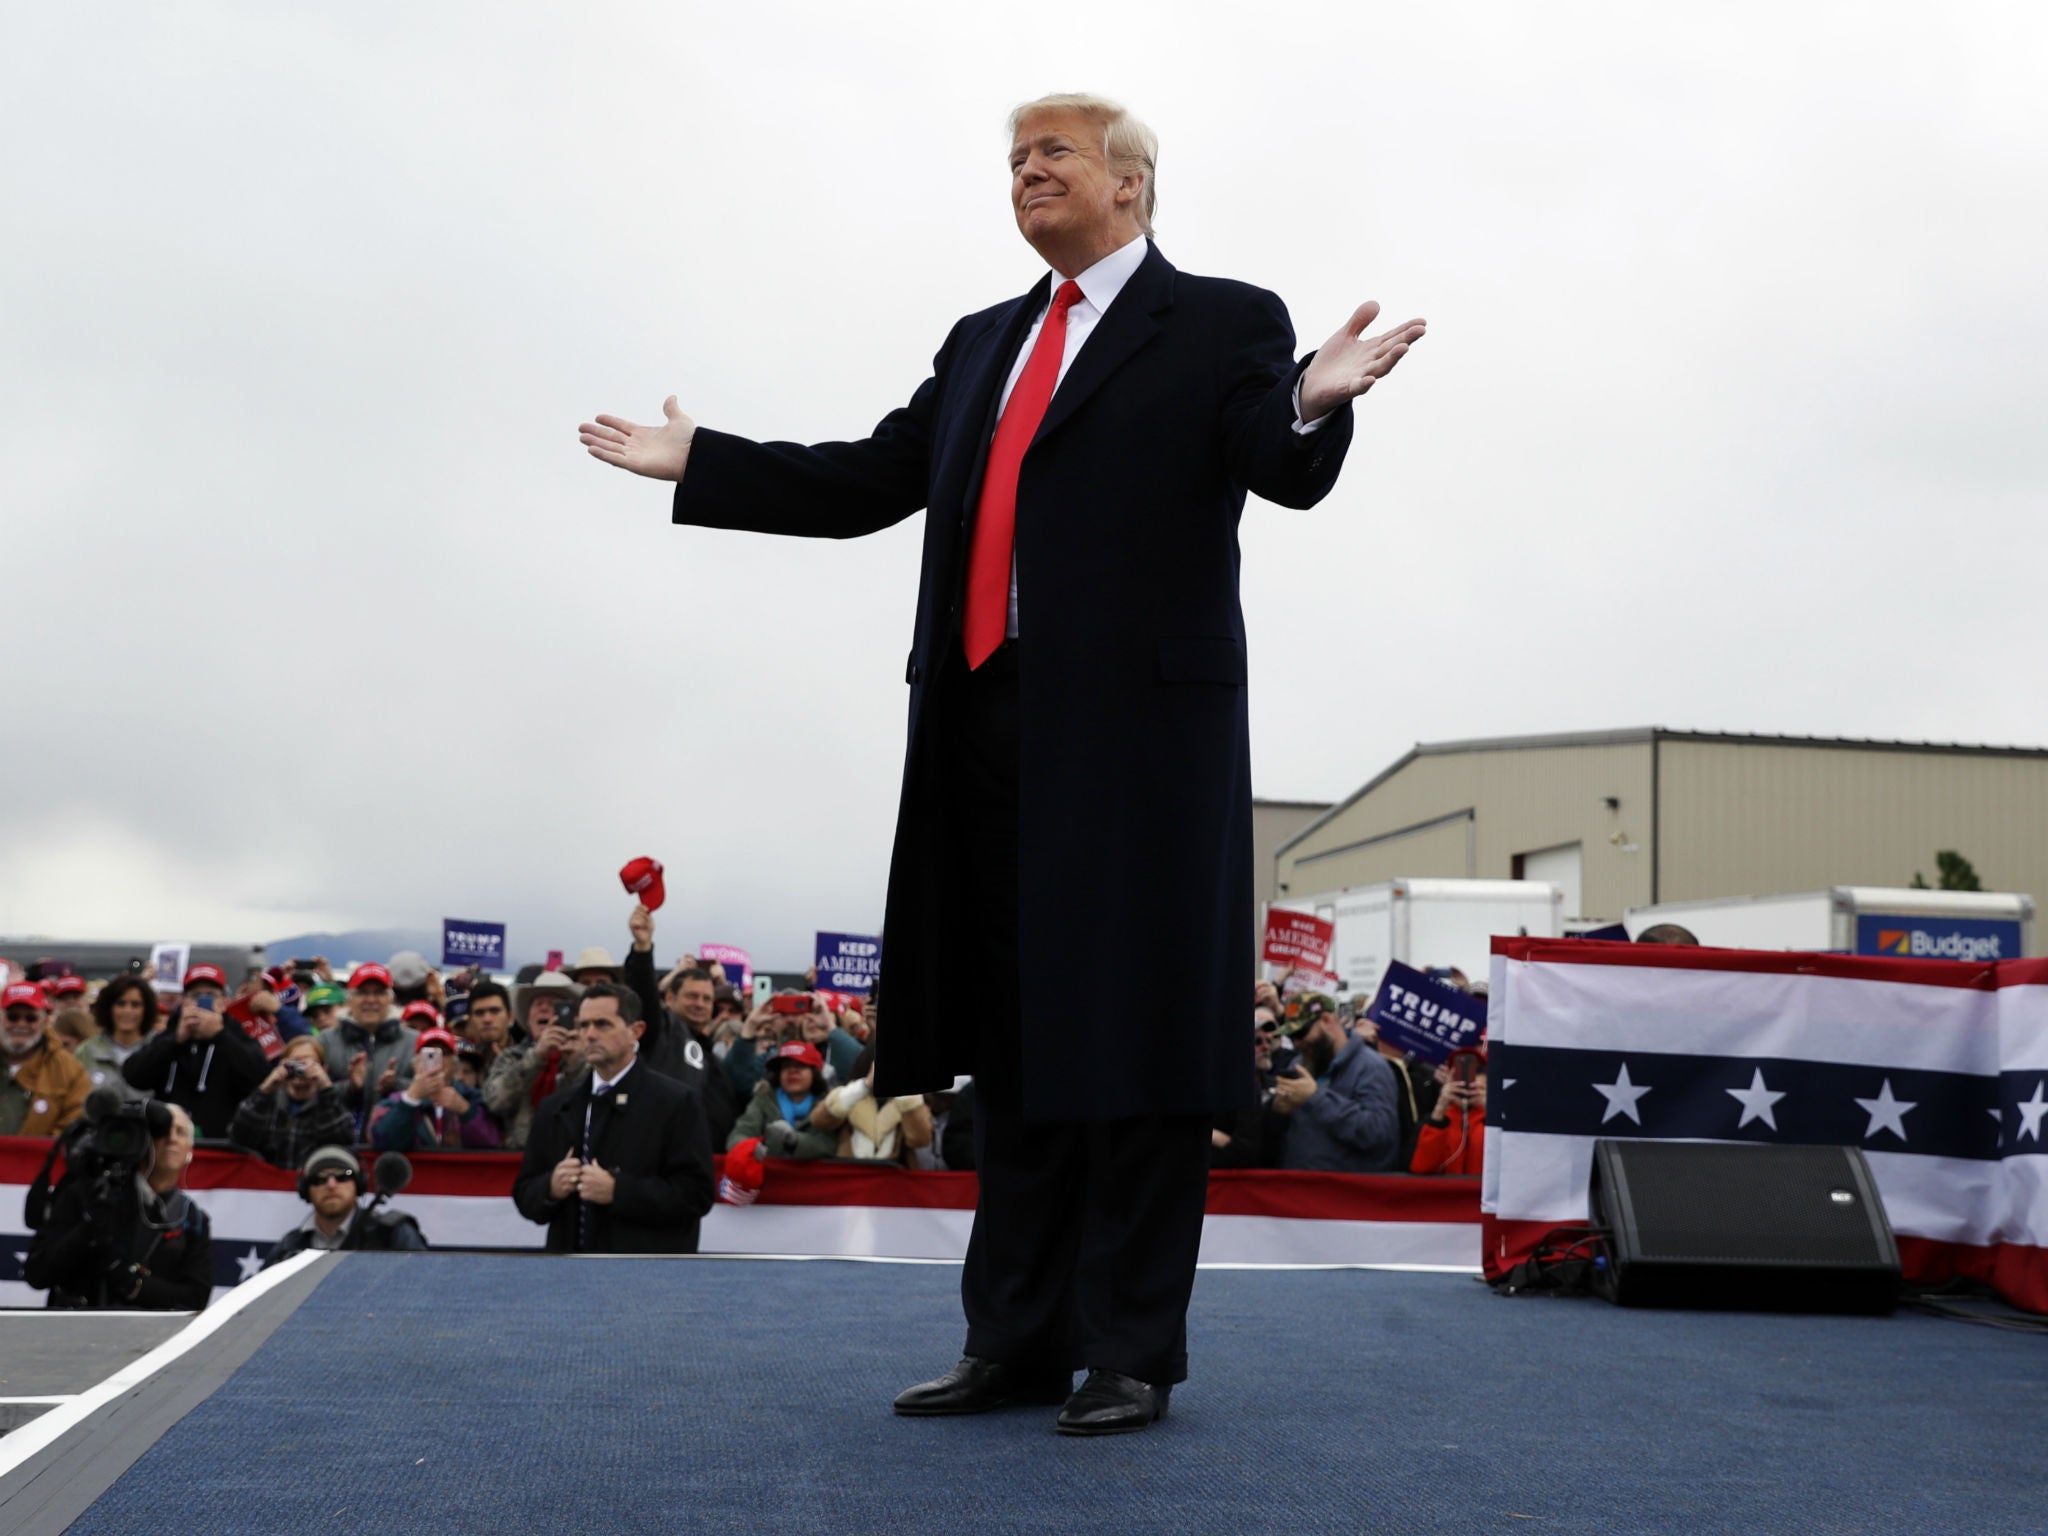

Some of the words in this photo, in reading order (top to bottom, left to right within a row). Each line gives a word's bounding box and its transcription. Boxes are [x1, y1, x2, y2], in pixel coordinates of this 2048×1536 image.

[447, 930, 501, 944] TRUMP
[838, 941, 877, 957] KEEP
[1911, 930, 2000, 962] Budget
[818, 955, 881, 974] AMERIC
[1389, 983, 1477, 1033] TRUMP
[1391, 1002, 1461, 1043] PENCE
[684, 1040, 704, 1069] Q
